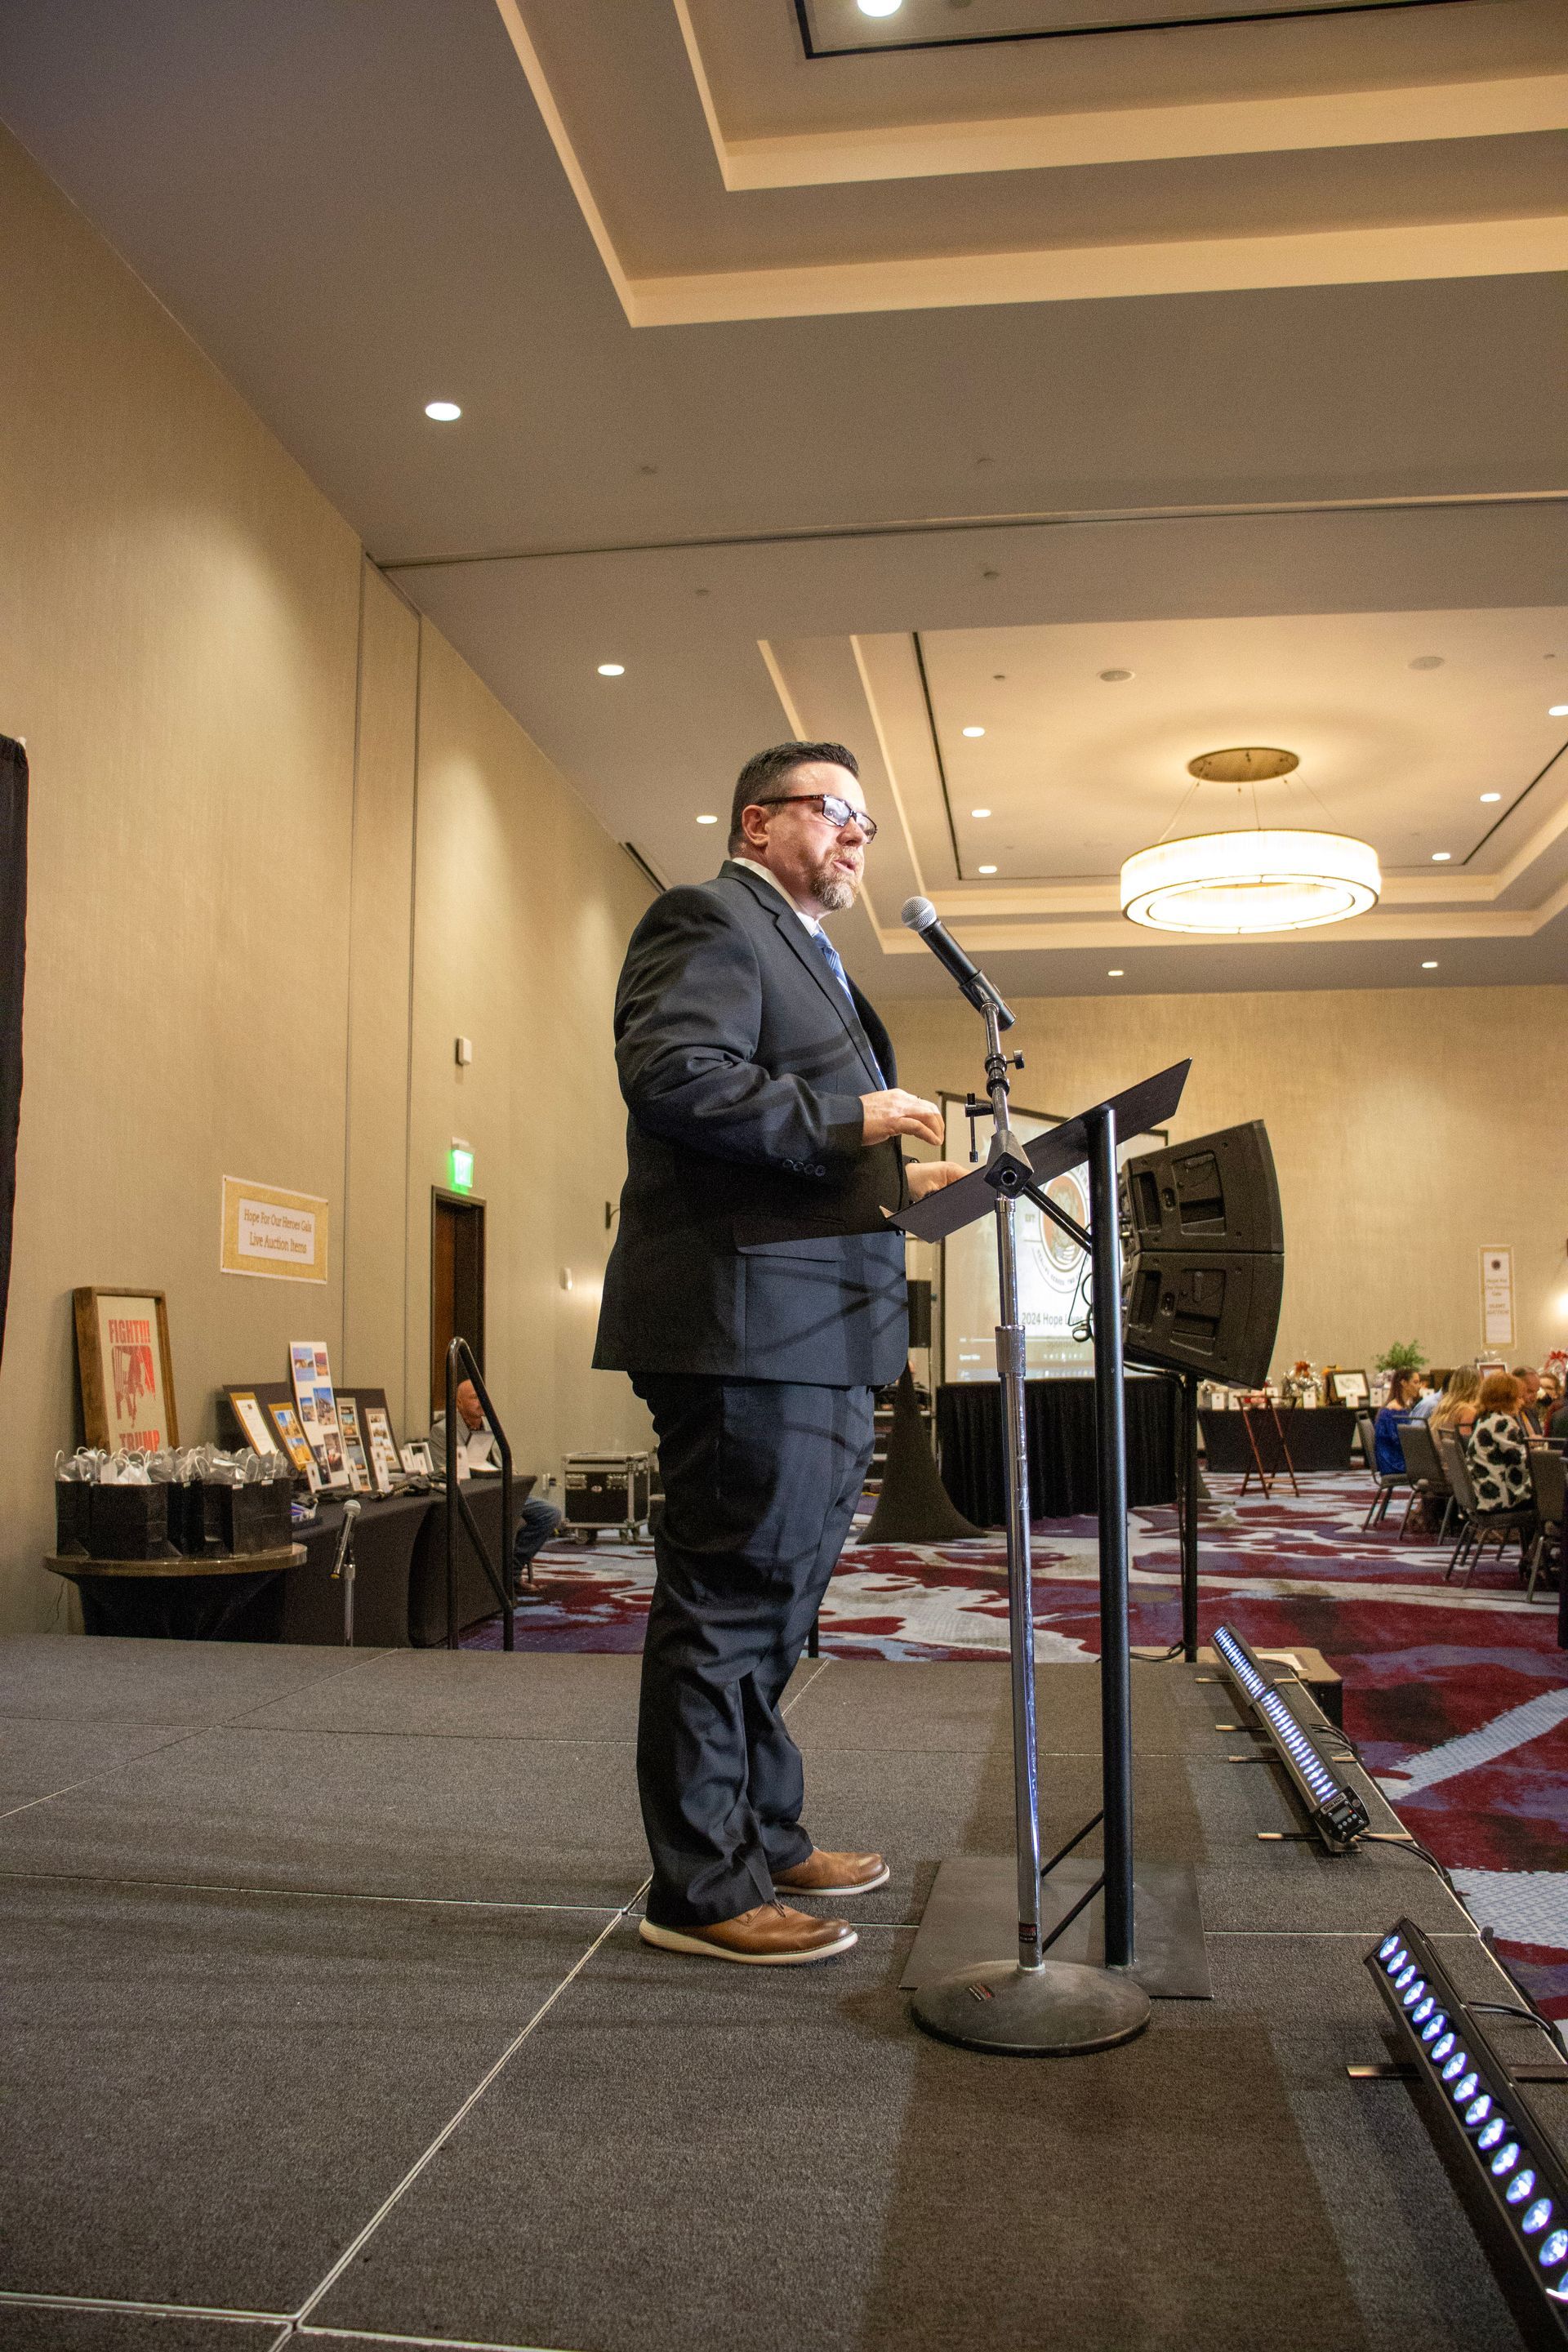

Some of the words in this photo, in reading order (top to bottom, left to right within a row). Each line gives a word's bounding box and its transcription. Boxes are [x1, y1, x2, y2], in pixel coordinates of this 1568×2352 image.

[243, 1209, 260, 1226] Hope
[261, 1212, 270, 1224] For
[270, 1214, 282, 1227] Our
[282, 1216, 301, 1230] Heroes
[301, 1220, 312, 1232] Gala
[249, 1232, 263, 1246] Live
[264, 1235, 289, 1251] Auction
[290, 1238, 307, 1254] Items
[1022, 1312, 1040, 1325] 2024
[1043, 1312, 1063, 1328] Hope
[109, 1320, 151, 1343] FIGHT!!!
